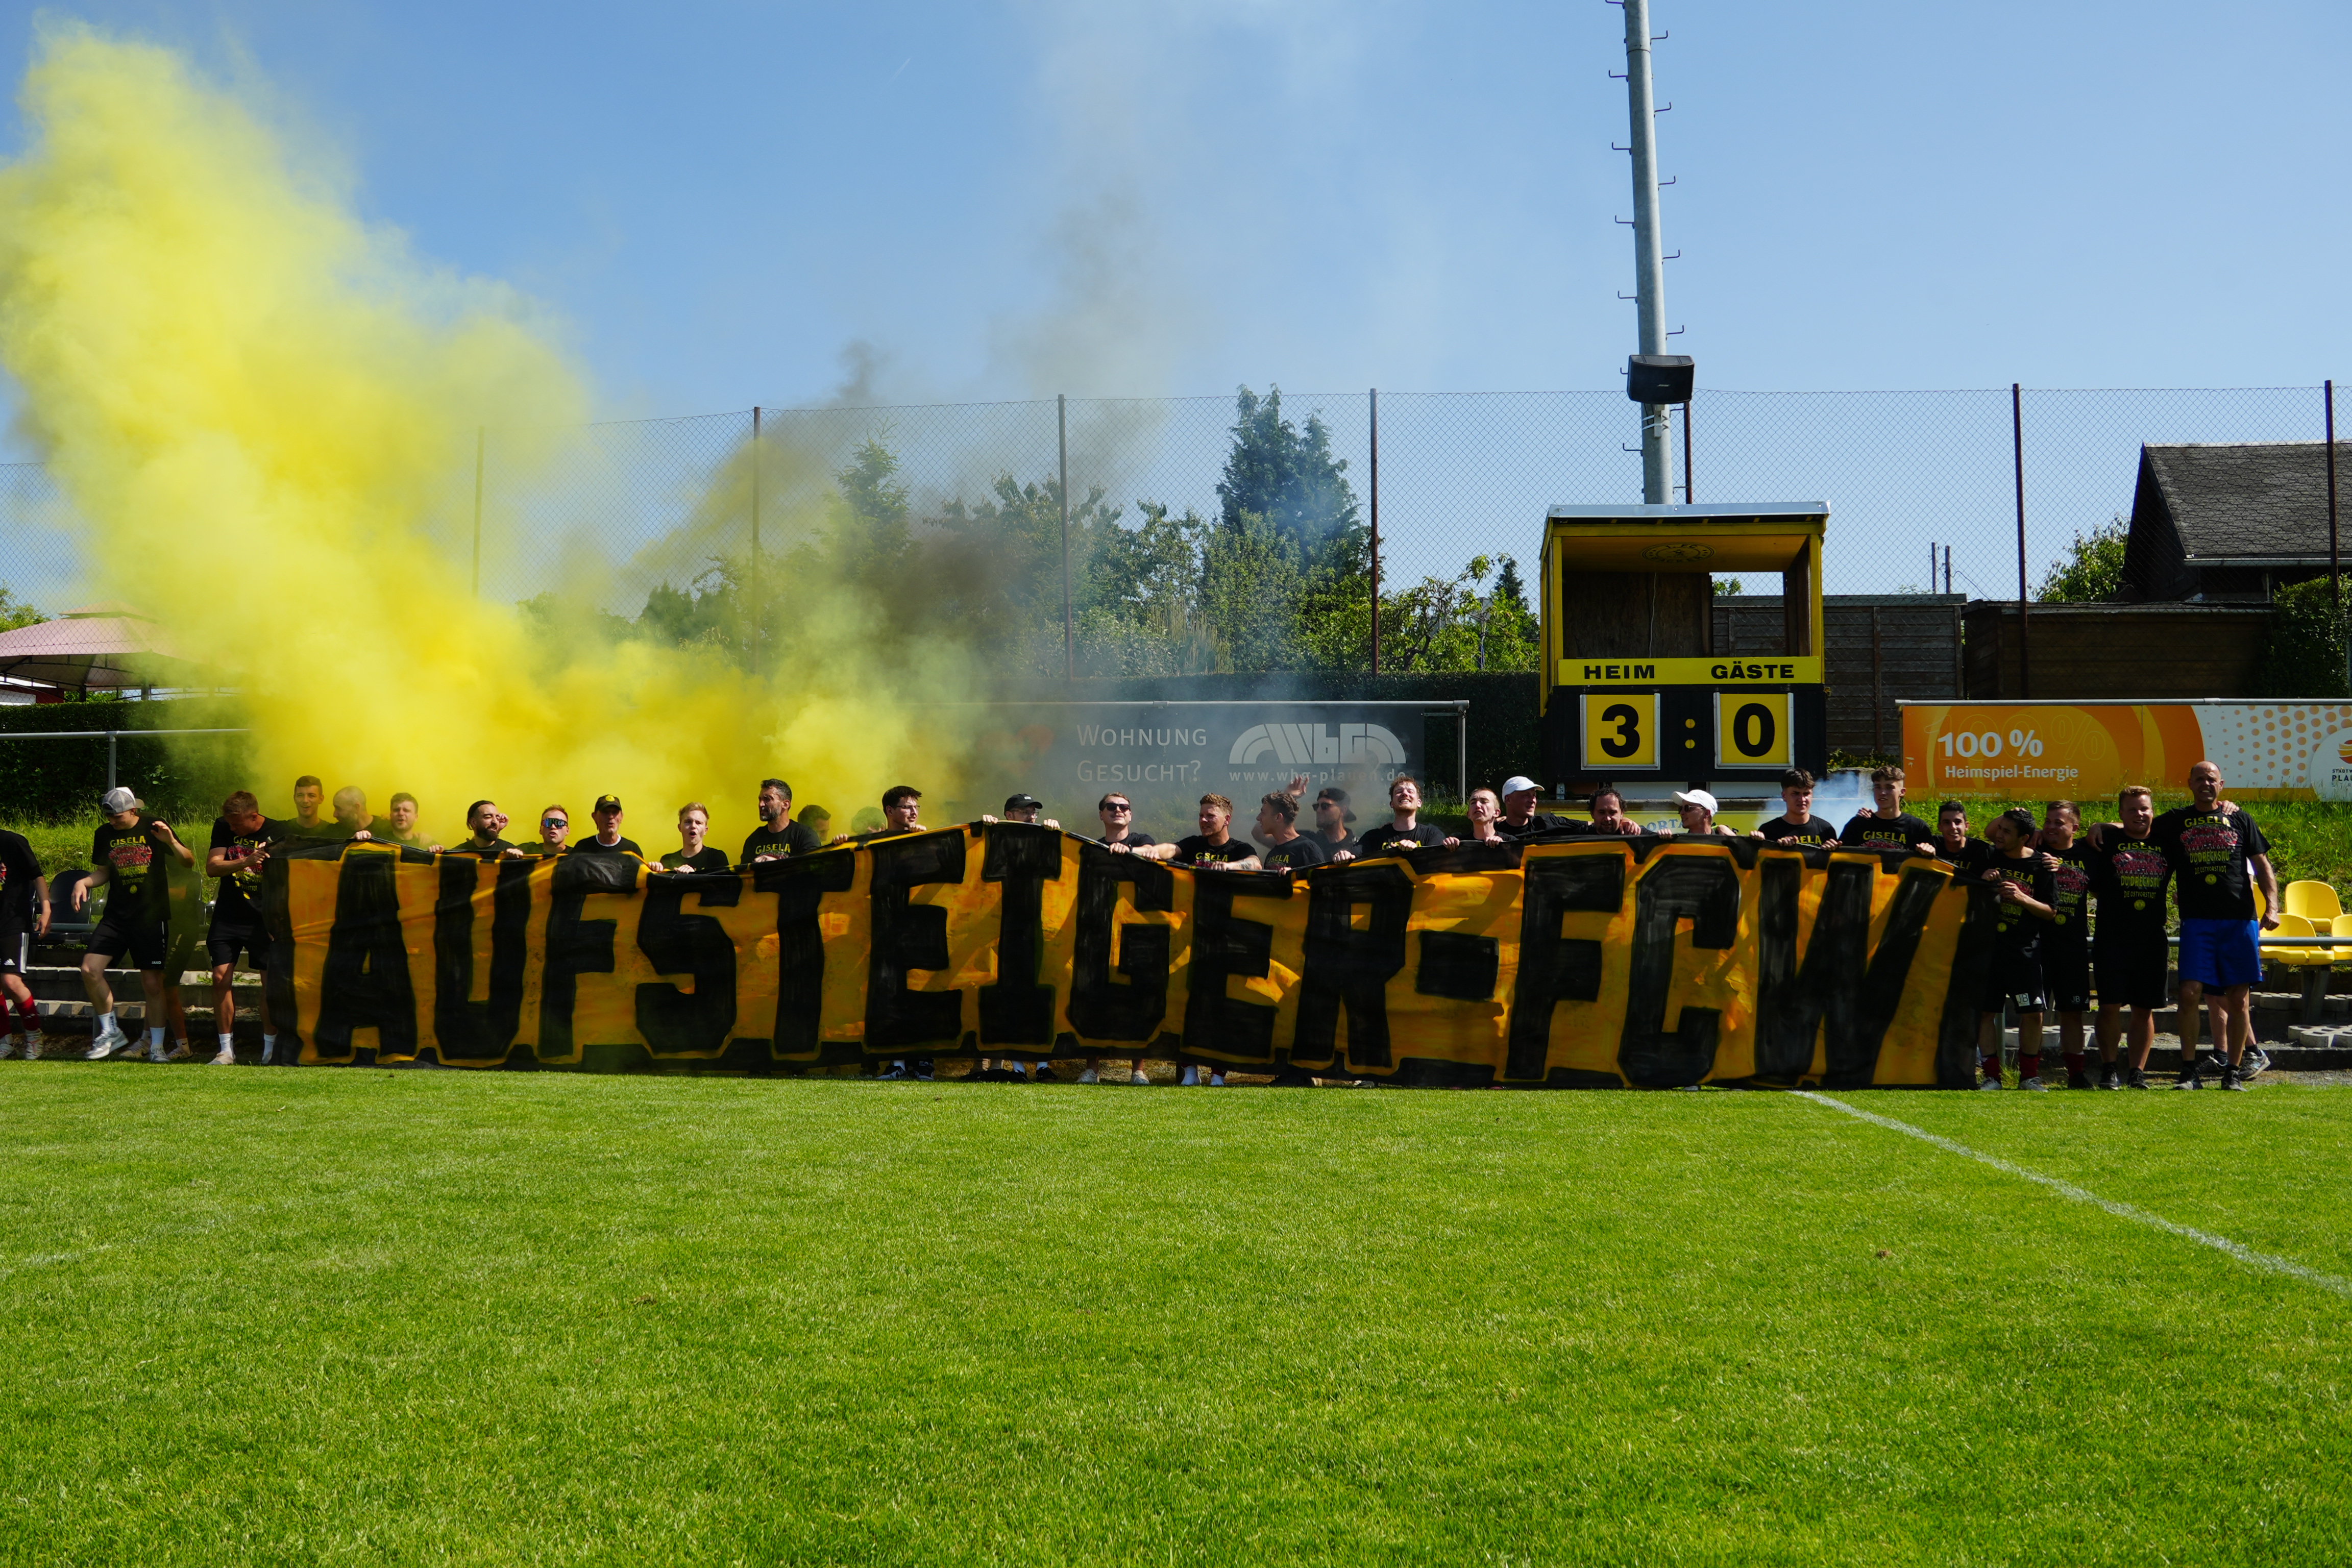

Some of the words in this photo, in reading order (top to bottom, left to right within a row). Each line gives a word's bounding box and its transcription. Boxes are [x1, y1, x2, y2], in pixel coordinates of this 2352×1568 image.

[1584, 665, 1655, 679] HEIM
[1711, 661, 1794, 679] GÄSTE
[1076, 724, 1207, 747] WOHNUNG
[1600, 704, 1640, 758] 3
[1733, 703, 1775, 757] 0
[1938, 732, 2002, 757] 100
[2009, 729, 2043, 757] %
[1077, 760, 1202, 782] GESUCHT?
[1945, 765, 2078, 782] Heimspiel-Energie
[2184, 816, 2231, 827] GISELA
[110, 836, 146, 848] GISELA
[233, 836, 259, 849] GISEL
[1863, 830, 1907, 844] GISELA
[755, 843, 791, 854] GISELA
[2117, 842, 2162, 852] GISELA
